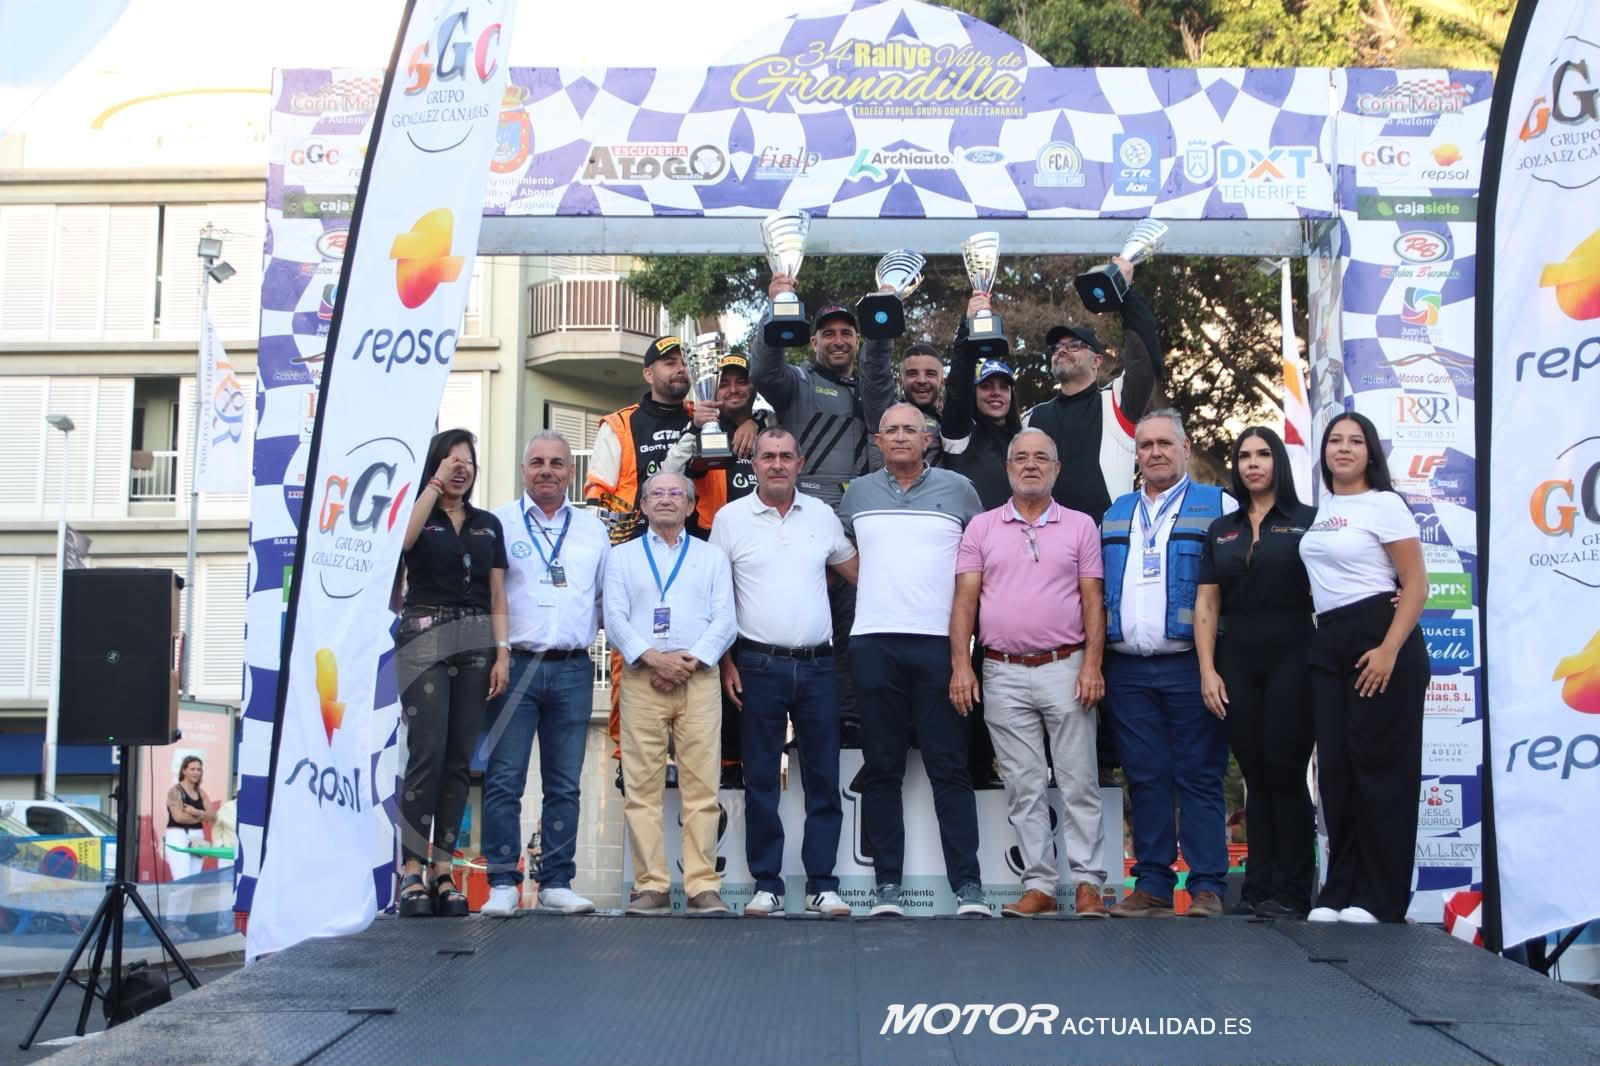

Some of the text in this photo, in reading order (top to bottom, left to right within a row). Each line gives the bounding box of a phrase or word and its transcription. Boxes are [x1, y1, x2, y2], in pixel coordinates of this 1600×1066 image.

[795, 40, 1024, 69] 34 Rallye Villa de
[730, 56, 1023, 111] Granadilla
[290, 144, 340, 165] GGC
[612, 146, 688, 156] ESCUDERIA
[871, 151, 950, 165] Archiauto
[1360, 145, 1411, 167] GGC
[1048, 152, 1070, 171] FCA
[1220, 148, 1313, 180] DXT
[1119, 168, 1152, 178] CTR
[1420, 168, 1470, 181] repsol
[1221, 184, 1307, 200] TENERIFE
[1394, 201, 1461, 216] cajasiete
[1395, 396, 1454, 424] R&R
[1407, 455, 1447, 479] LF
[1423, 808, 1451, 817] JESUS
[902, 898, 934, 908] Abona
